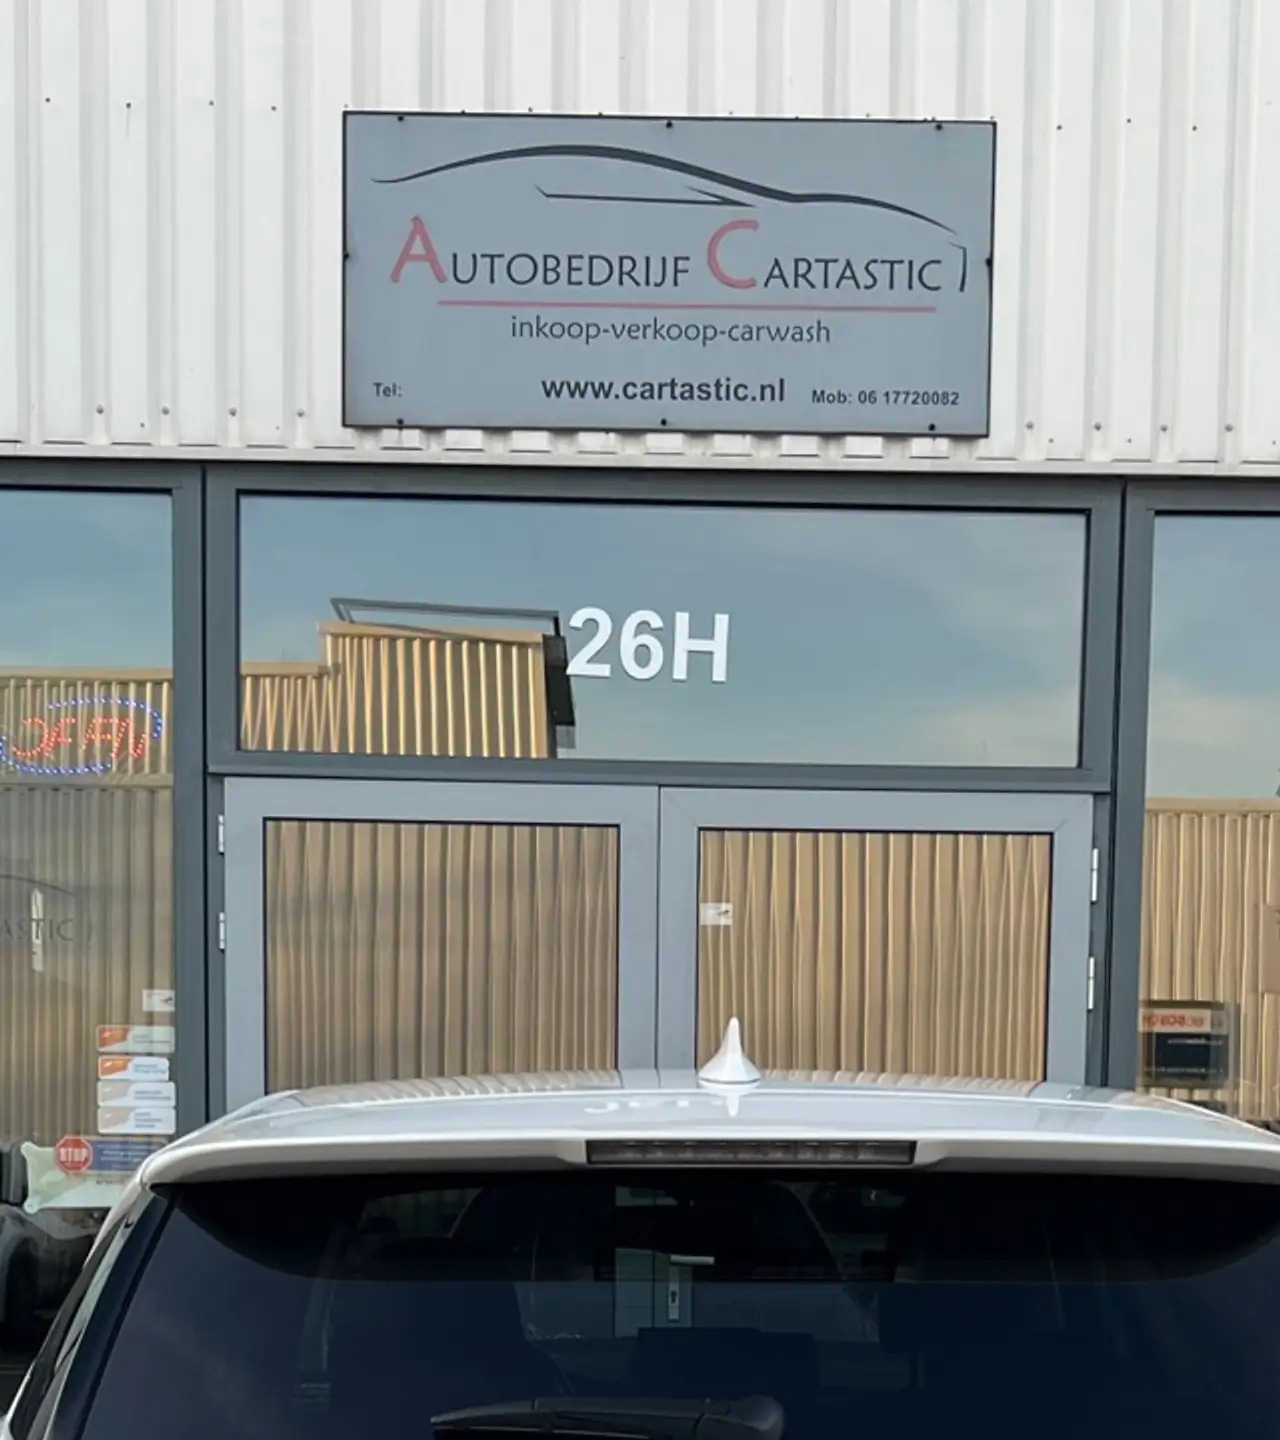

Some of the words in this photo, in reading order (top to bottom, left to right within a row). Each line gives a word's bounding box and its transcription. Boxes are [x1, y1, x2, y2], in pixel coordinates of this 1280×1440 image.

[389, 214, 692, 289] AUTOBEDRIJF
[706, 218, 944, 292] CARTASTIC
[511, 314, 832, 348] inkoop-verkoop-carwash
[373, 382, 404, 399] Tel:
[541, 376, 786, 403] www.cartastic.nl
[811, 389, 853, 405] Mob:
[858, 390, 878, 405] 06
[883, 390, 961, 406] 17720082
[566, 606, 730, 682] 26H
[59, 1146, 88, 1162] STOP
